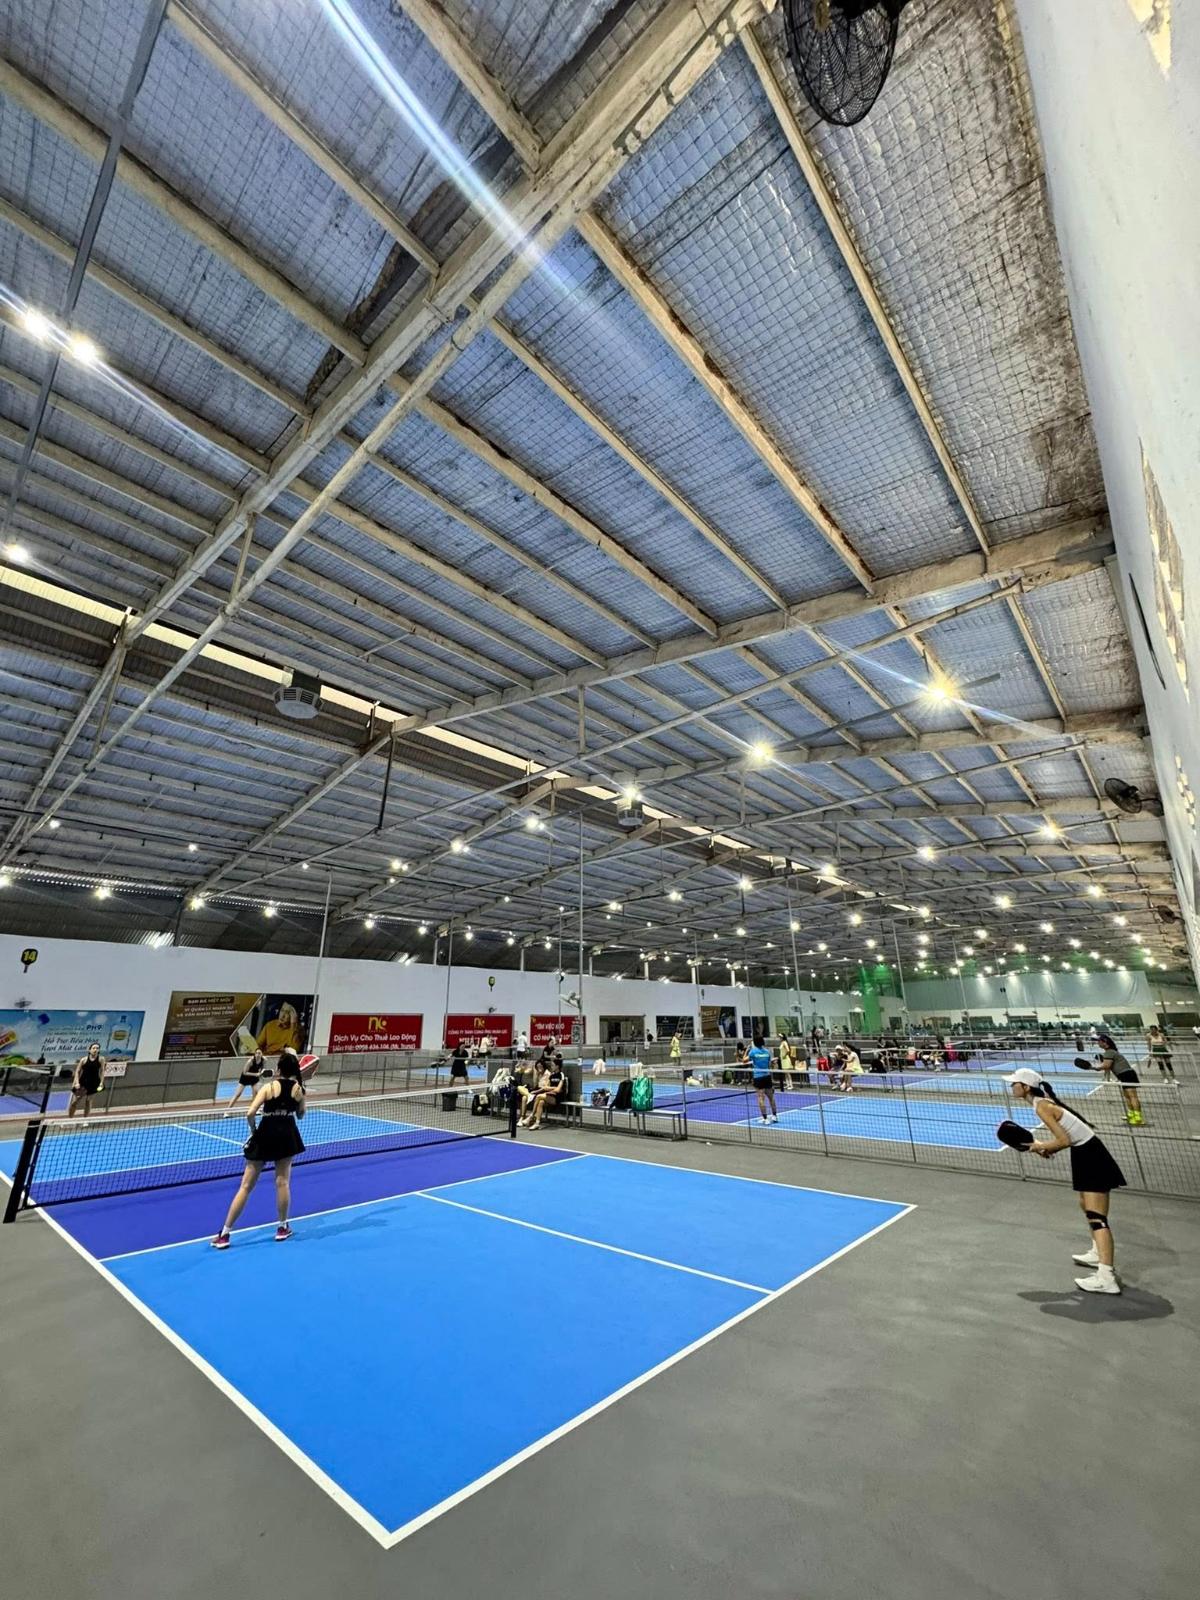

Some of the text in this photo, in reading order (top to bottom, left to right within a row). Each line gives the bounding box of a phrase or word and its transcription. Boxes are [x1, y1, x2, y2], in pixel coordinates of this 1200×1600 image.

[23, 951, 36, 961] 14
[334, 1034, 348, 1043] Dịch
[350, 1034, 359, 1042] Vụ
[374, 1033, 388, 1041] Thuê
[401, 1034, 417, 1042] Động
